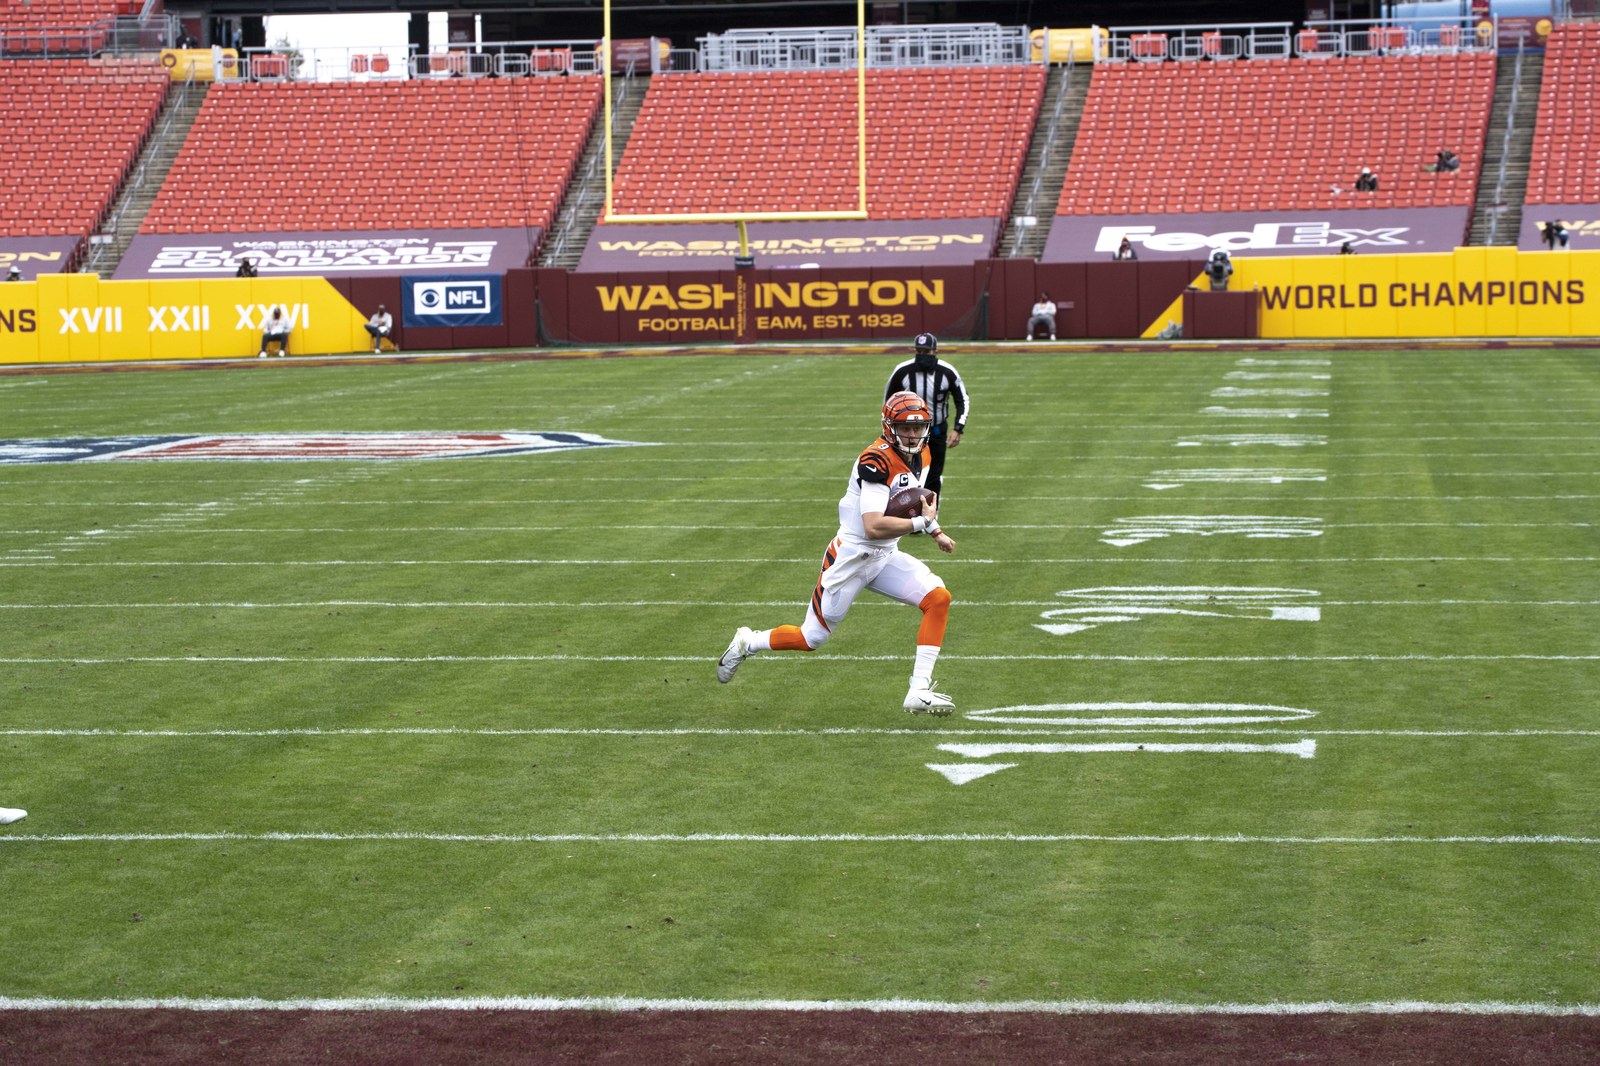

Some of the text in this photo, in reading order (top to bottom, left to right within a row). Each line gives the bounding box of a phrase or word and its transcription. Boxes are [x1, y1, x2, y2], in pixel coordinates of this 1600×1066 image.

[598, 233, 984, 252] WASHINGTON
[1094, 221, 1411, 253] FedEx
[151, 253, 492, 268] FOUNDATION
[156, 245, 495, 260] CHARITABLE
[448, 289, 484, 306] NFL
[596, 279, 945, 312] WASHINGTON
[1261, 279, 1585, 311] WORLD CHAMPIONS
[58, 303, 310, 335] XVII XXII XXVI
[756, 315, 807, 331] EAM,
[813, 315, 852, 329] EST.
[858, 313, 905, 328] 1932
[901, 474, 909, 484] C
[1040, 585, 1322, 622] 20
[935, 701, 1321, 760] 10
